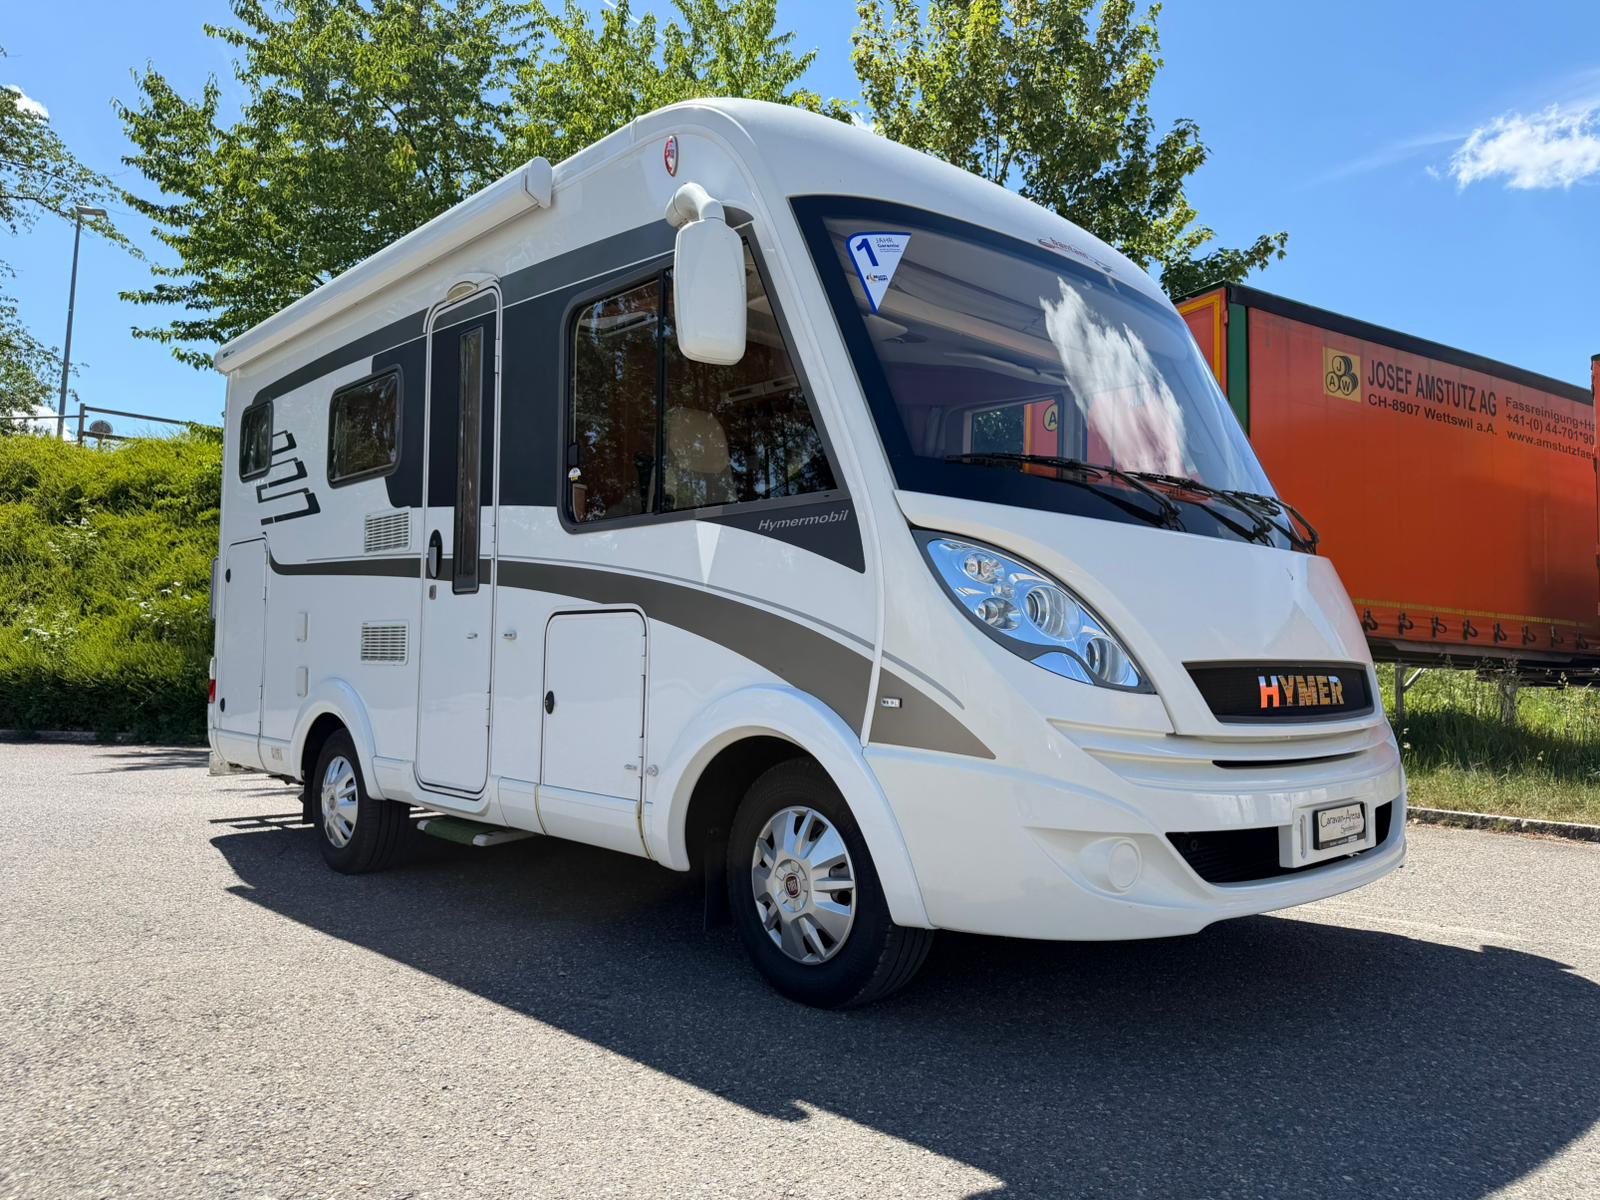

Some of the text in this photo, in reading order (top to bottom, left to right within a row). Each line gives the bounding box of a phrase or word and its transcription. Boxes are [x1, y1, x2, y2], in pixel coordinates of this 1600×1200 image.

[856, 238, 879, 266] 1
[1329, 375, 1336, 387] A
[1341, 379, 1350, 392] W
[1368, 359, 1497, 417] JOSEF AMSTUTZ AG
[1368, 393, 1420, 416] CH-8907
[1424, 406, 1473, 430] Wettswil
[1506, 412, 1543, 433] +41-(0)
[758, 509, 849, 531] Hymermobil
[1257, 674, 1345, 709] HYMER
